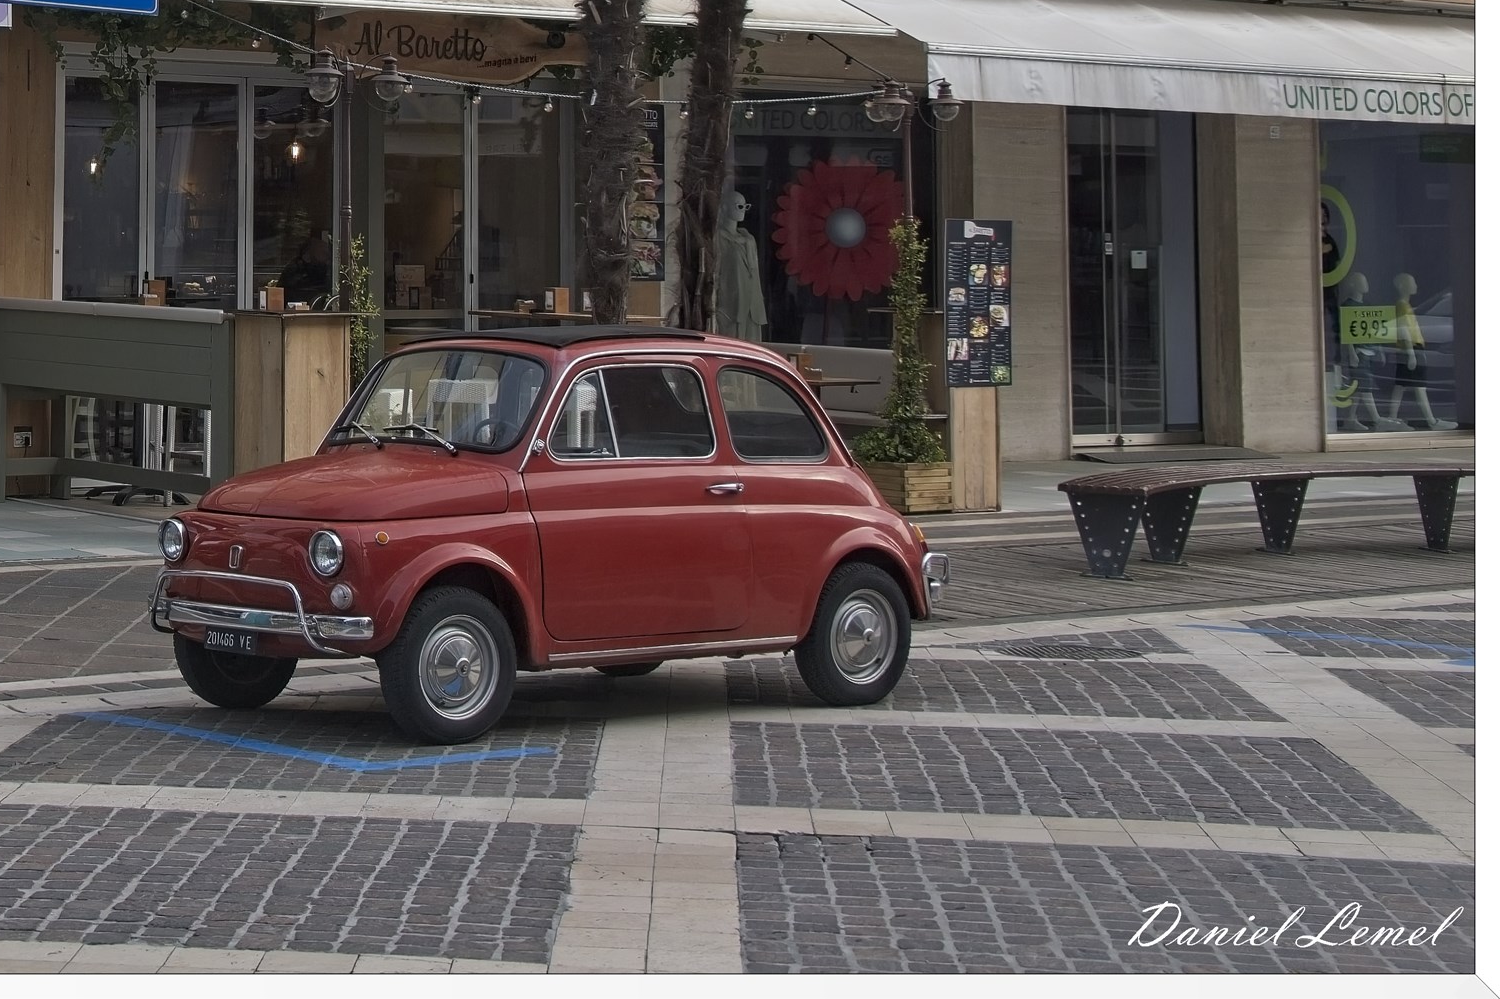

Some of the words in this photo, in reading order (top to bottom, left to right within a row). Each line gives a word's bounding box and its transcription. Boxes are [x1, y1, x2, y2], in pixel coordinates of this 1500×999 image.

[348, 20, 383, 56] Al
[387, 24, 492, 62] Baretto
[1283, 84, 1358, 112] UNITED
[1364, 88, 1443, 116] COLORS
[1447, 92, 1474, 117] OF
[206, 630, 235, 647] 201466
